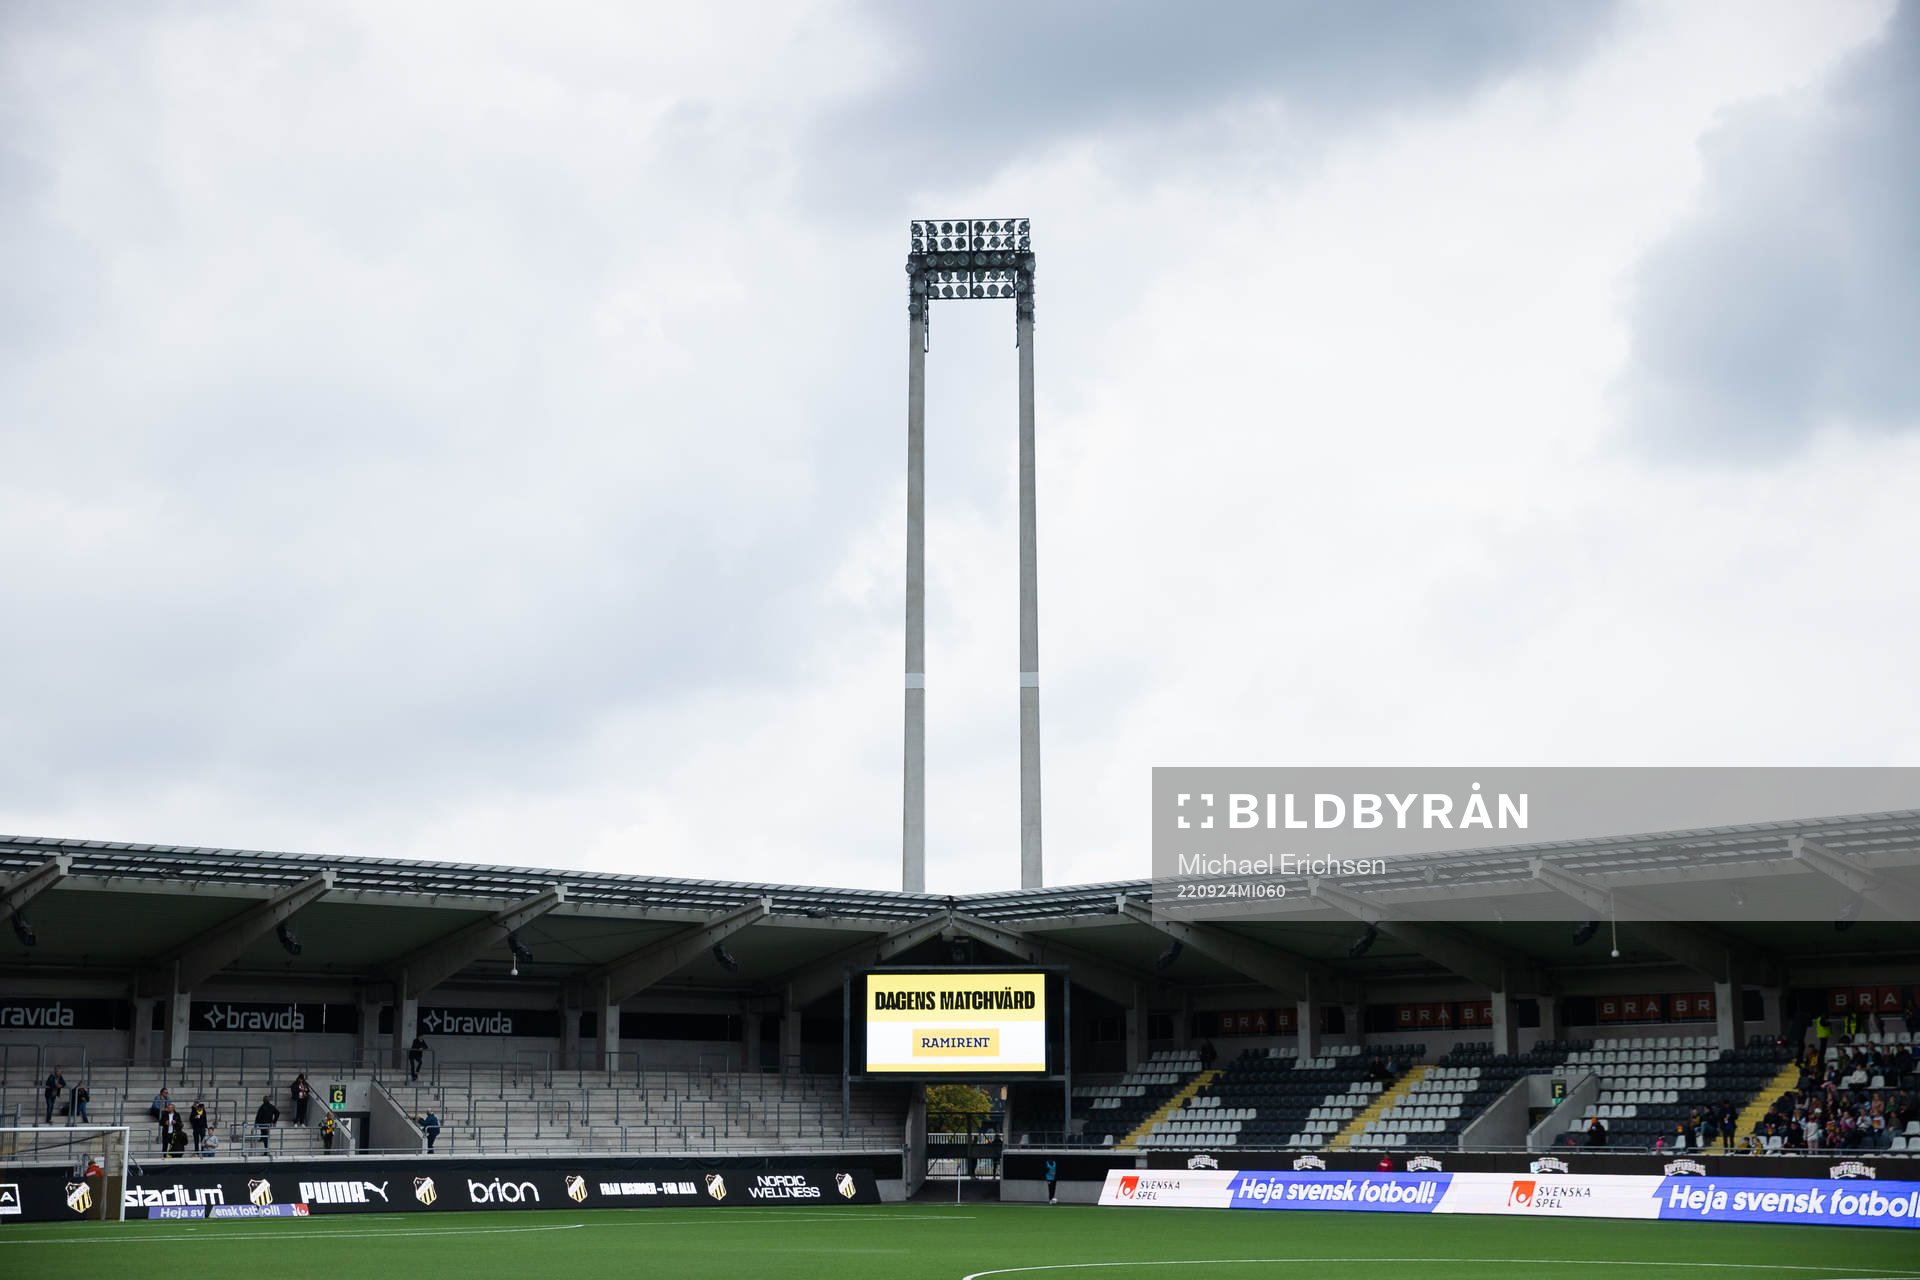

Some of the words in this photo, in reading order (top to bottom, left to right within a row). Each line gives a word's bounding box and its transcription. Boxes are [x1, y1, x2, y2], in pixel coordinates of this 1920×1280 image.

[875, 991, 936, 1011] DAGENS
[940, 986, 1036, 1010] MATCHVÄRD
[226, 1005, 305, 1030] bravida
[443, 1010, 513, 1034] bravida
[921, 1037, 991, 1048] RAMIRENT
[333, 1090, 343, 1103] G
[756, 1176, 806, 1187] NORDIC
[1141, 1181, 1180, 1189] SVENSKA
[125, 1184, 225, 1207] stadium
[299, 1182, 366, 1203] PUMA
[467, 1177, 540, 1203] brion
[748, 1187, 821, 1198] WELLNESS
[1136, 1191, 1158, 1200] SPEL
[1239, 1178, 1284, 1204] Heja
[1286, 1179, 1356, 1201] svensk
[1358, 1180, 1438, 1205] fotboll!
[1538, 1186, 1591, 1197] SVENSKA
[1535, 1199, 1563, 1208] SPEL
[1669, 1184, 1729, 1215] Heja
[1732, 1188, 1827, 1214] svensk
[160, 1206, 188, 1219] Heja
